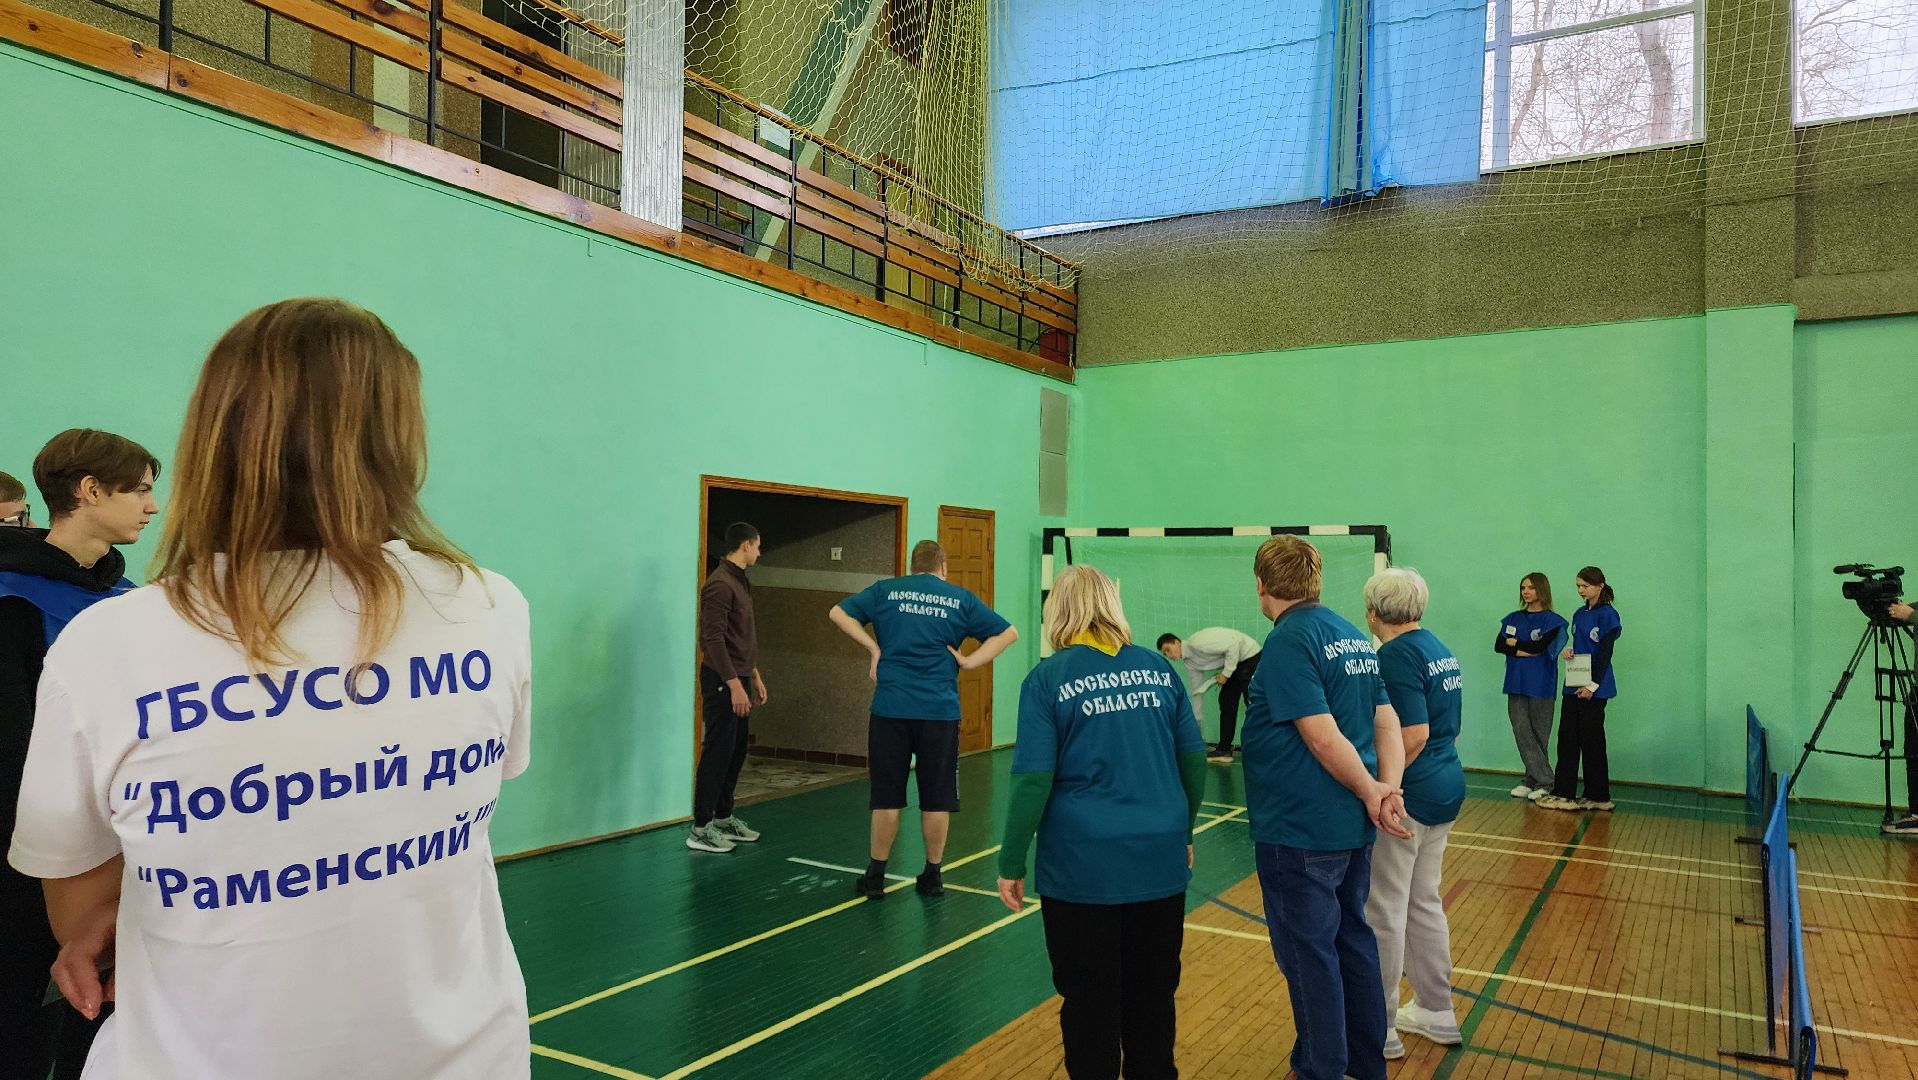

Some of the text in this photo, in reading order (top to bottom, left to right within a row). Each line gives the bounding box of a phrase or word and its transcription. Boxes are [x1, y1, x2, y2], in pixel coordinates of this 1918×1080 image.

[888, 591, 961, 610] МОСКОВСКАЯ
[898, 603, 948, 619] ОБЛАСТЬ
[136, 650, 491, 740] ГБСУСО МО
[1058, 669, 1172, 702] МОСКОВСКАЯ
[1082, 691, 1161, 716] ОБЛАСТЬ
